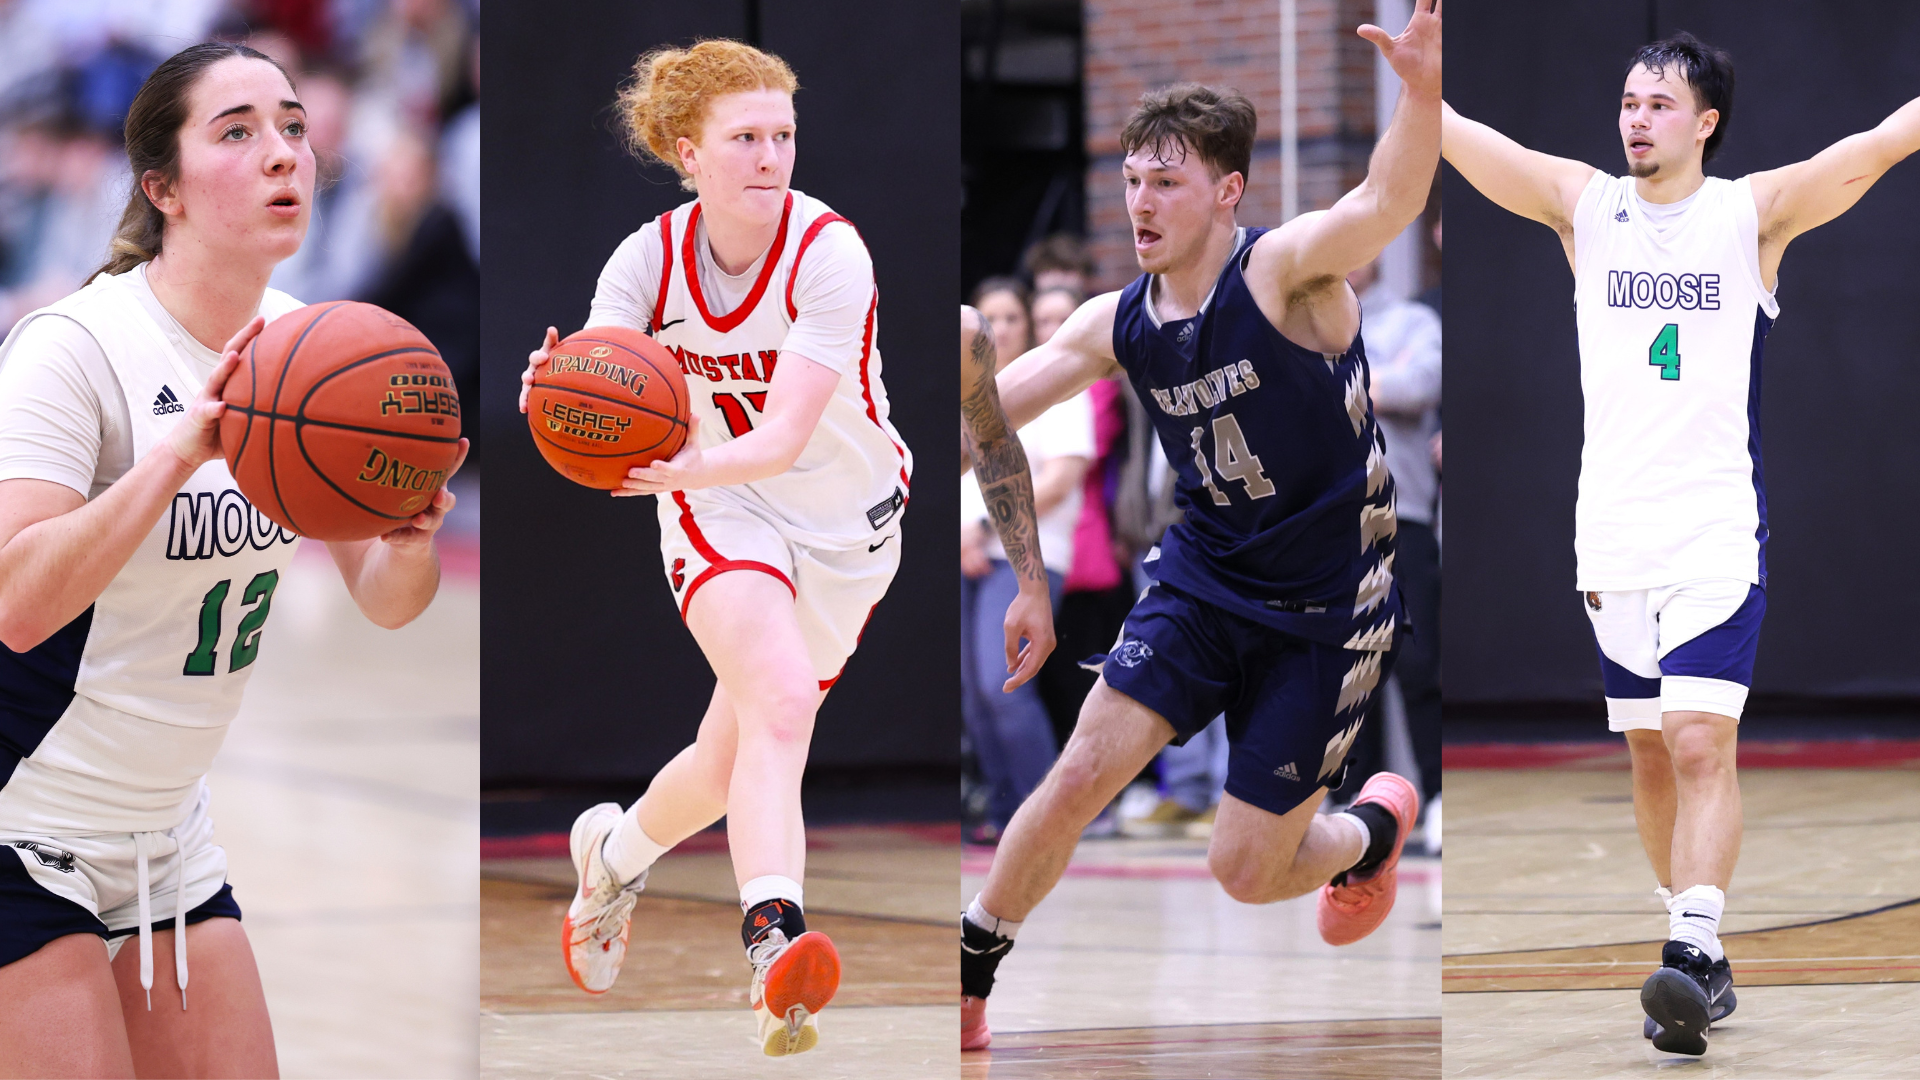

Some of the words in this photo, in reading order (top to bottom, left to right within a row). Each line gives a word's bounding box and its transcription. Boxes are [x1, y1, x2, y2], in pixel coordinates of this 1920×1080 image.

[1608, 270, 1720, 310] MOOSE
[665, 345, 781, 384] MUSTAN
[1649, 323, 1681, 381] 4
[546, 353, 649, 398] SPALDING
[153, 402, 185, 416] adidas
[380, 391, 460, 418] EGACY
[542, 397, 632, 433] LEGACY
[563, 425, 621, 443] 1000
[356, 447, 449, 492] ALDING
[1190, 413, 1276, 506] 14
[166, 489, 300, 560] MOO
[183, 569, 279, 676] 12
[1273, 769, 1301, 782] adidas
